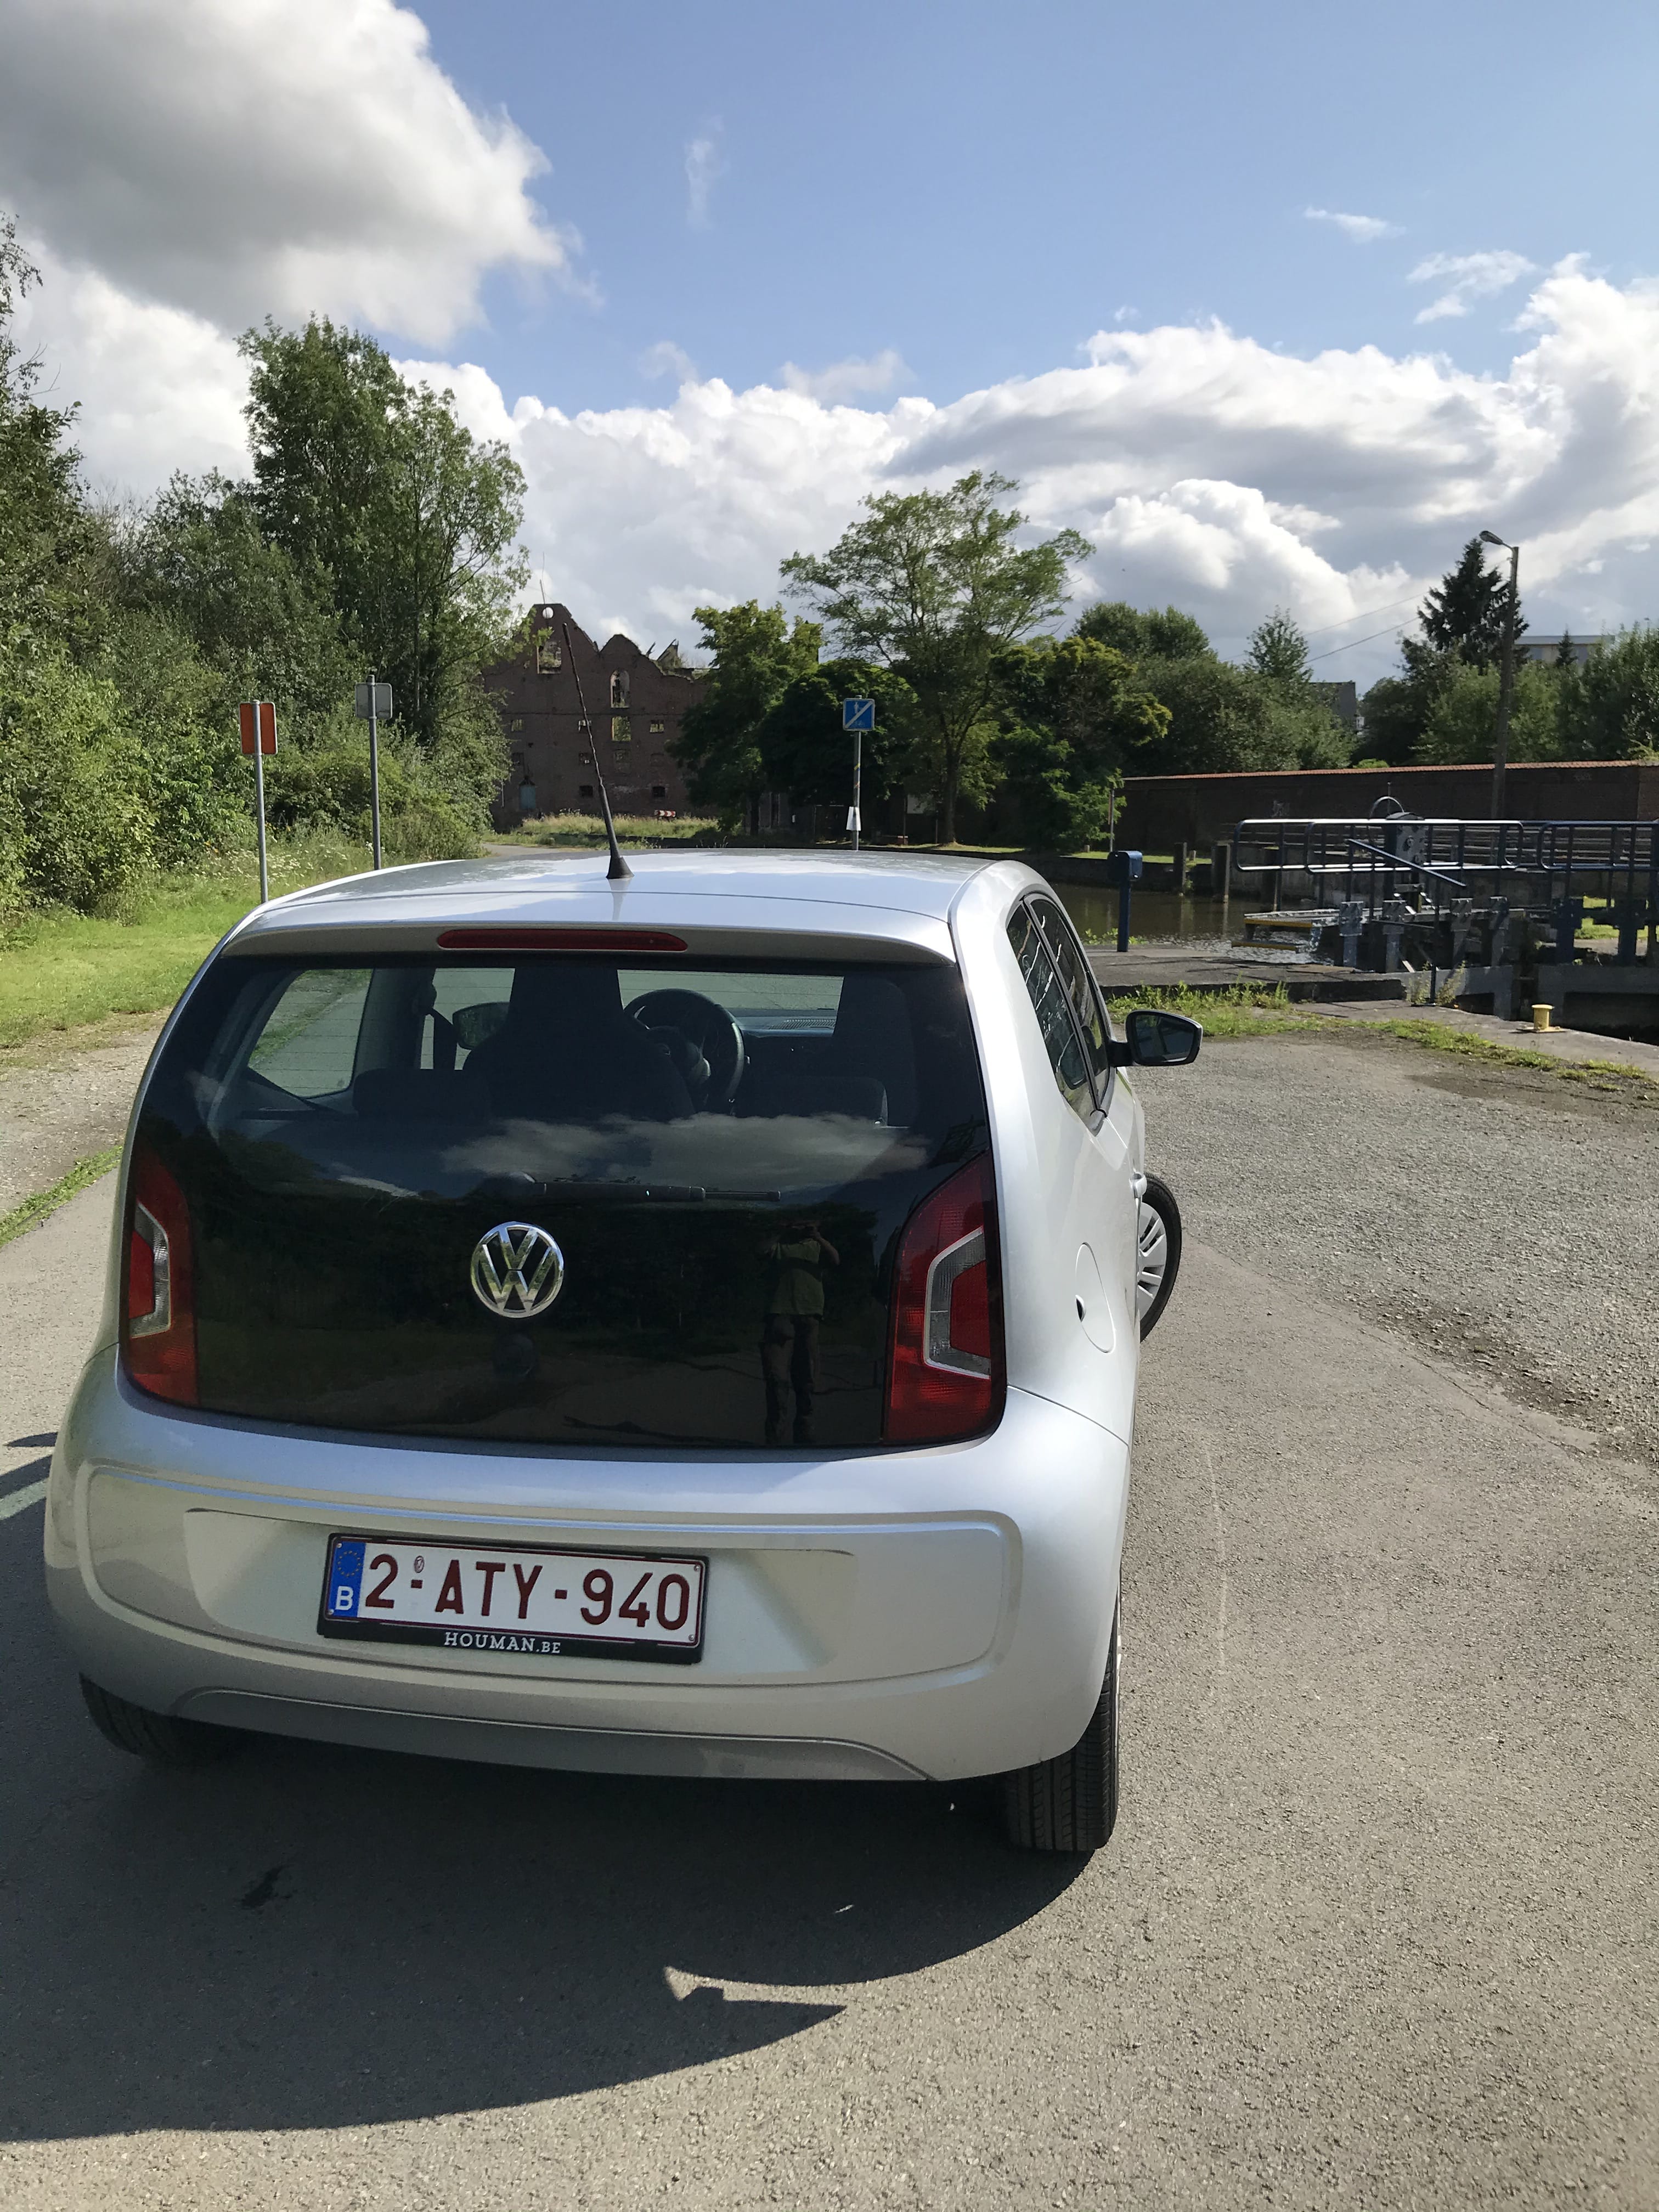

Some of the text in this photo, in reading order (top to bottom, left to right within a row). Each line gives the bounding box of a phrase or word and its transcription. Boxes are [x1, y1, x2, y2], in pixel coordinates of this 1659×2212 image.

[473, 1223, 561, 1317] VW
[335, 1585, 354, 1611] B
[365, 1553, 690, 1630] 2-ATY-940
[444, 1632, 561, 1654] HOUMAN.BE
